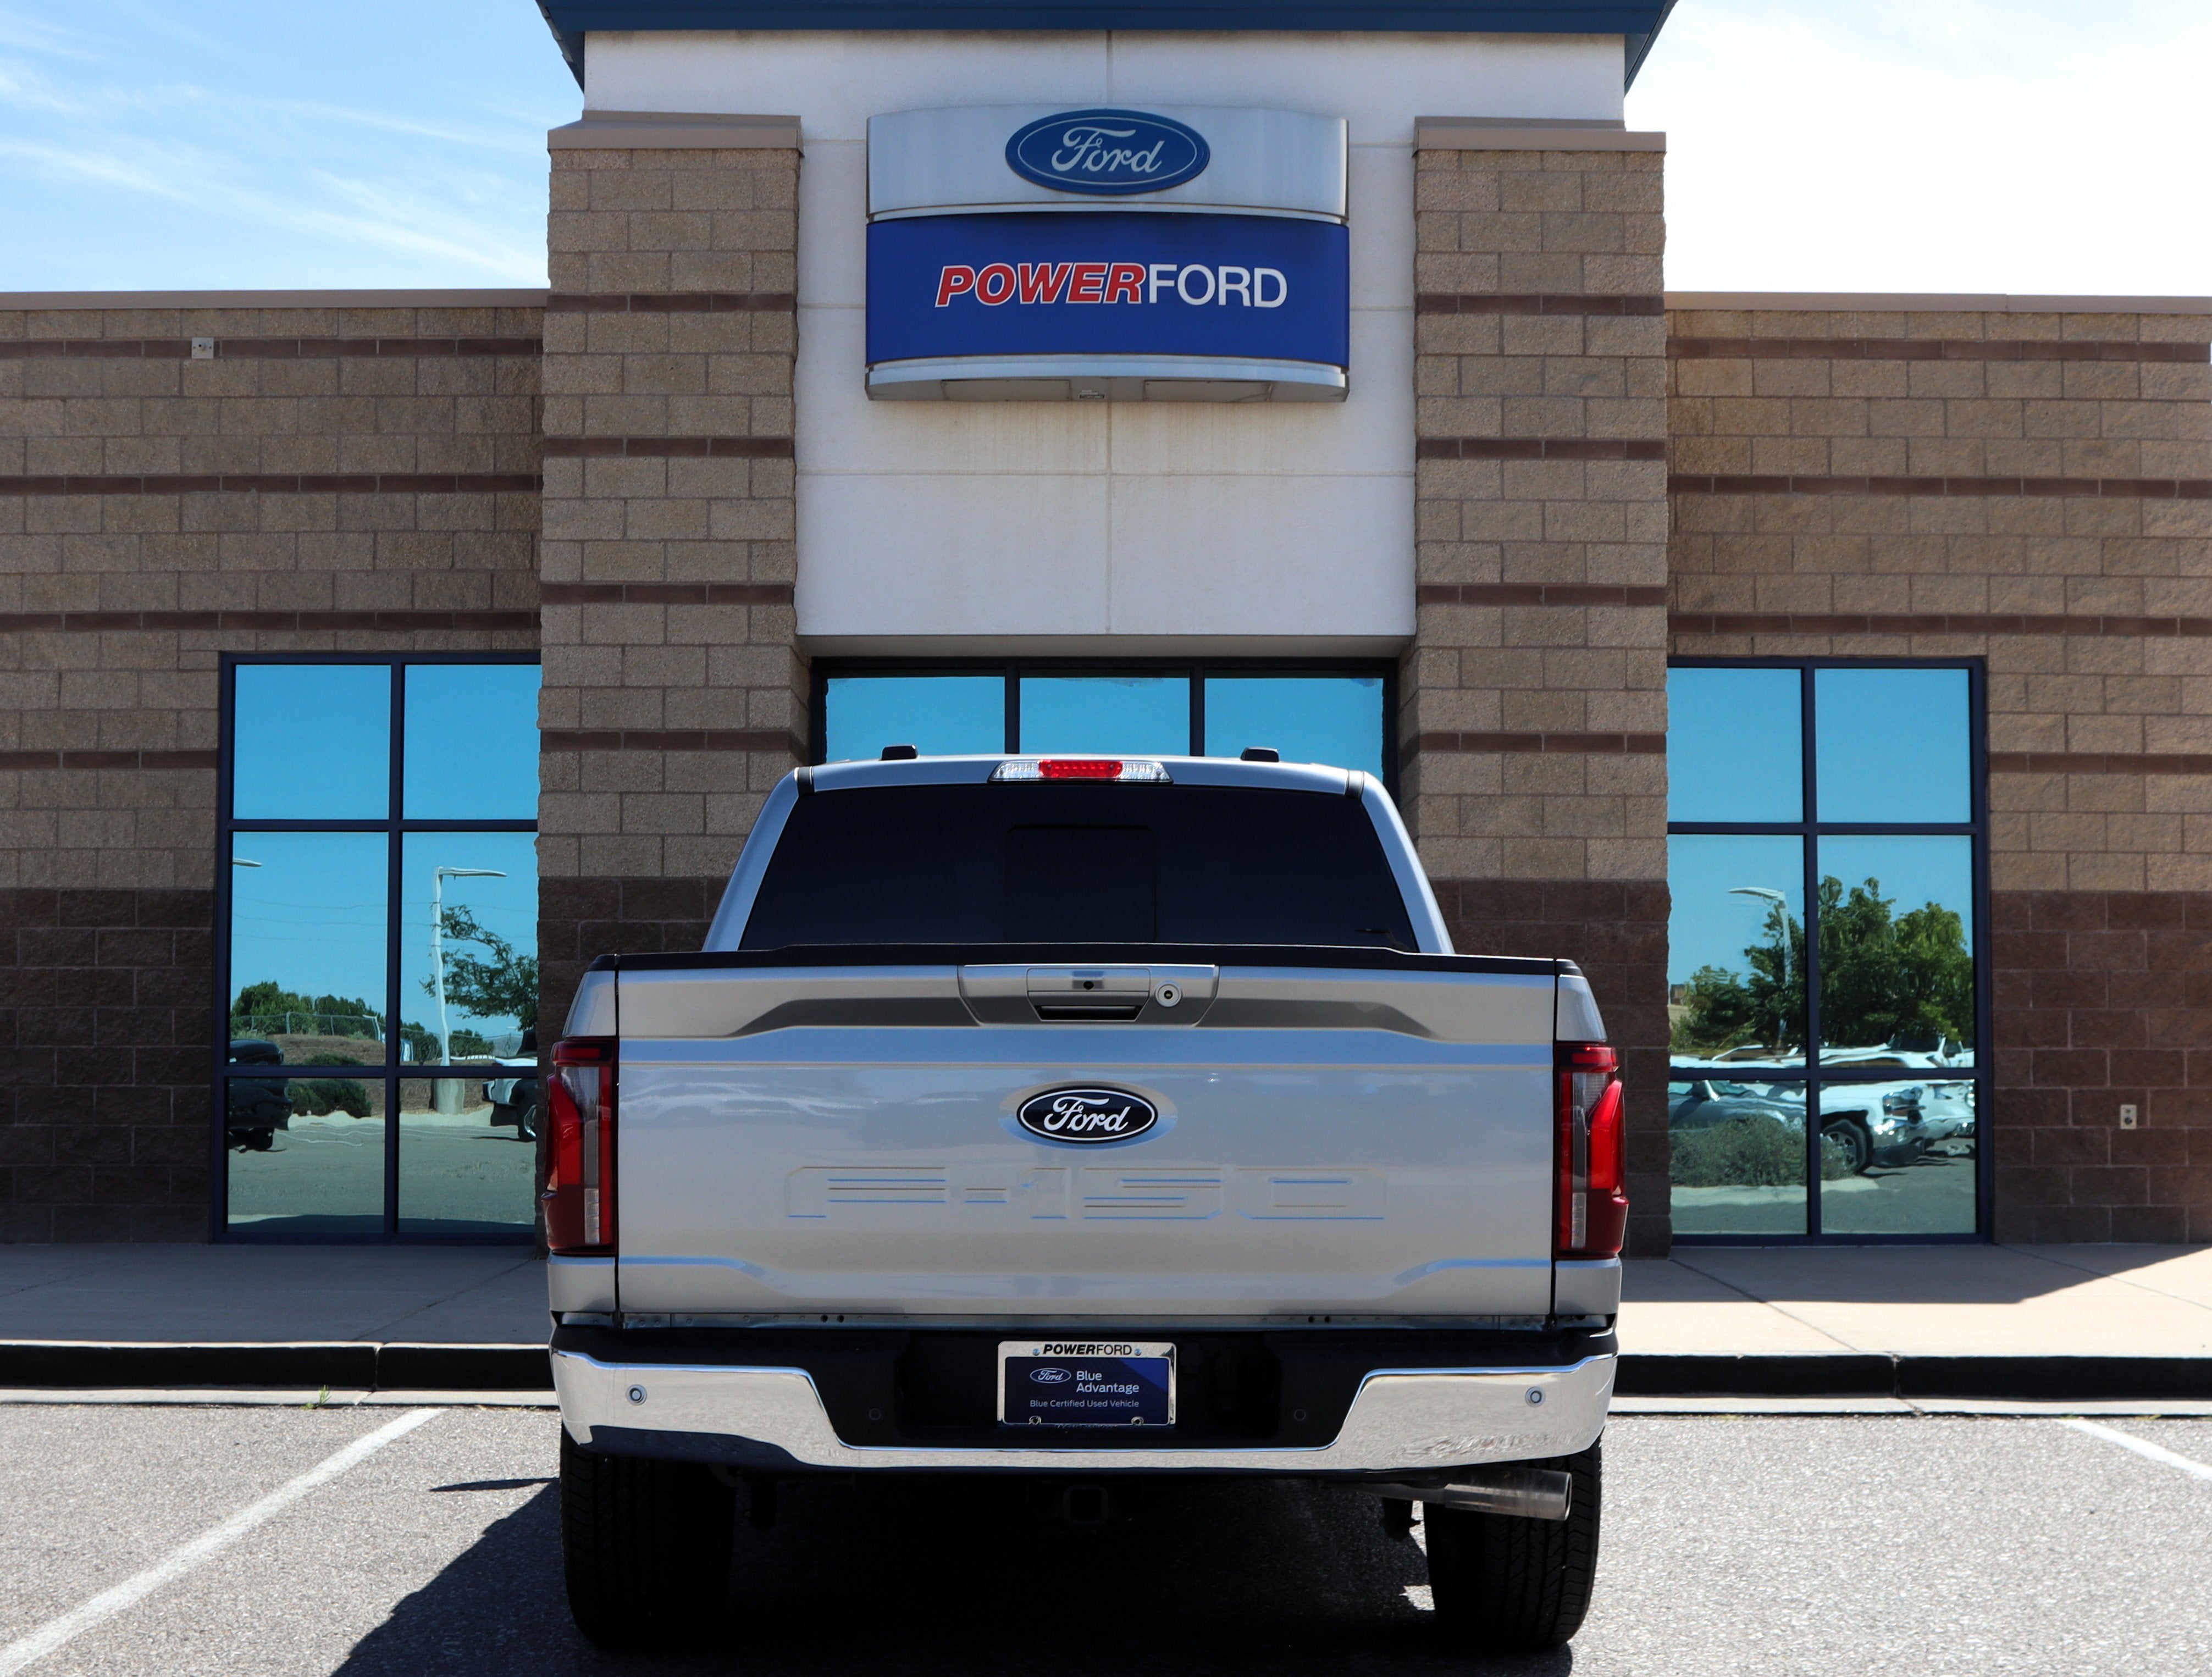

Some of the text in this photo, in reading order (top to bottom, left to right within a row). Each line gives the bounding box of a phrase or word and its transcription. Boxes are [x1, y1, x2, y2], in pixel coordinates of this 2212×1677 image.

[1050, 125, 1165, 173] Ford
[934, 262, 1288, 308] POWERFORD
[1043, 1094, 1131, 1136] Ford
[786, 1166, 1386, 1221] F-150
[1043, 1344, 1132, 1355] POWERFORD
[1037, 1369, 1064, 1381] Ford
[1076, 1370, 1103, 1381] Blue
[1076, 1382, 1140, 1394] Advantage
